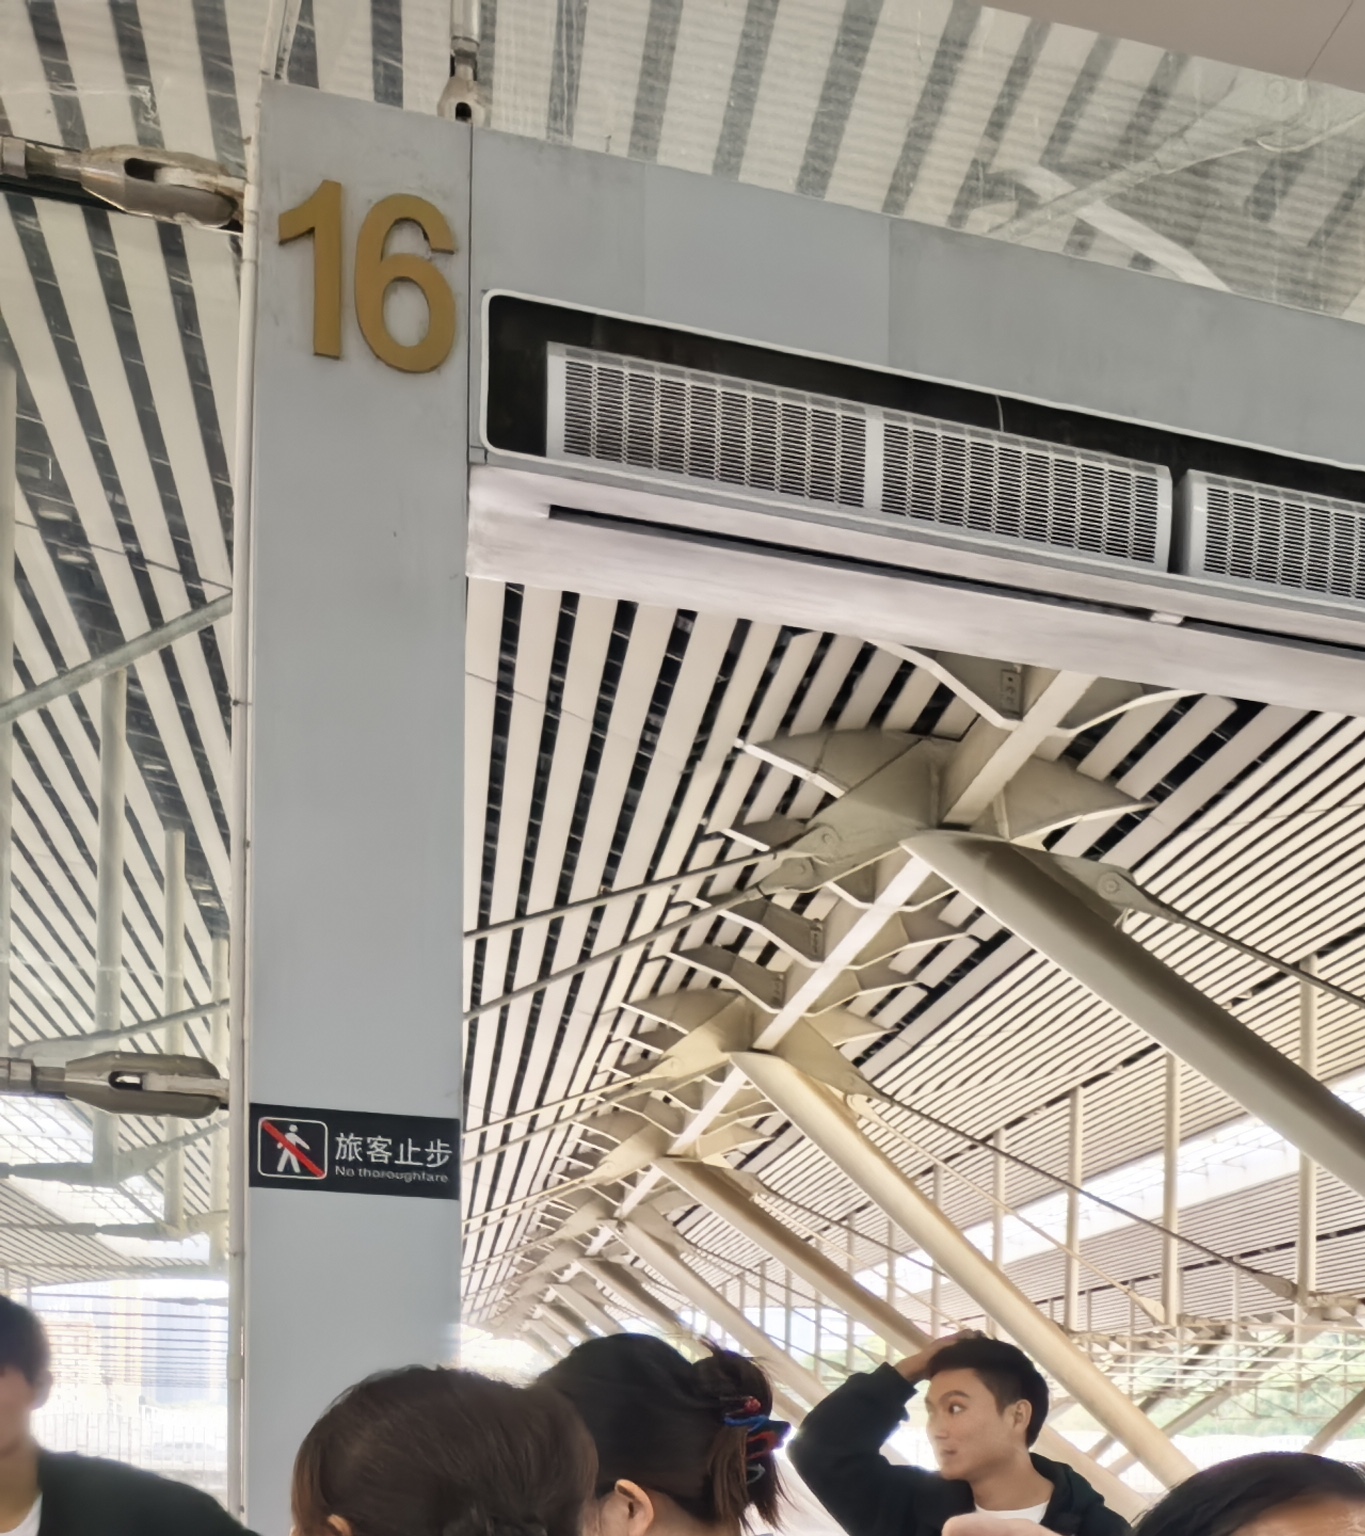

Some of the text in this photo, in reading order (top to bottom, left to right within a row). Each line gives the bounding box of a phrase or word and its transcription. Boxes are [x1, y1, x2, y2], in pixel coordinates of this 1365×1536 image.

[278, 179, 456, 374] 16
[335, 1132, 453, 1168] 旅客止步
[335, 1165, 449, 1184] No thoroughfare
